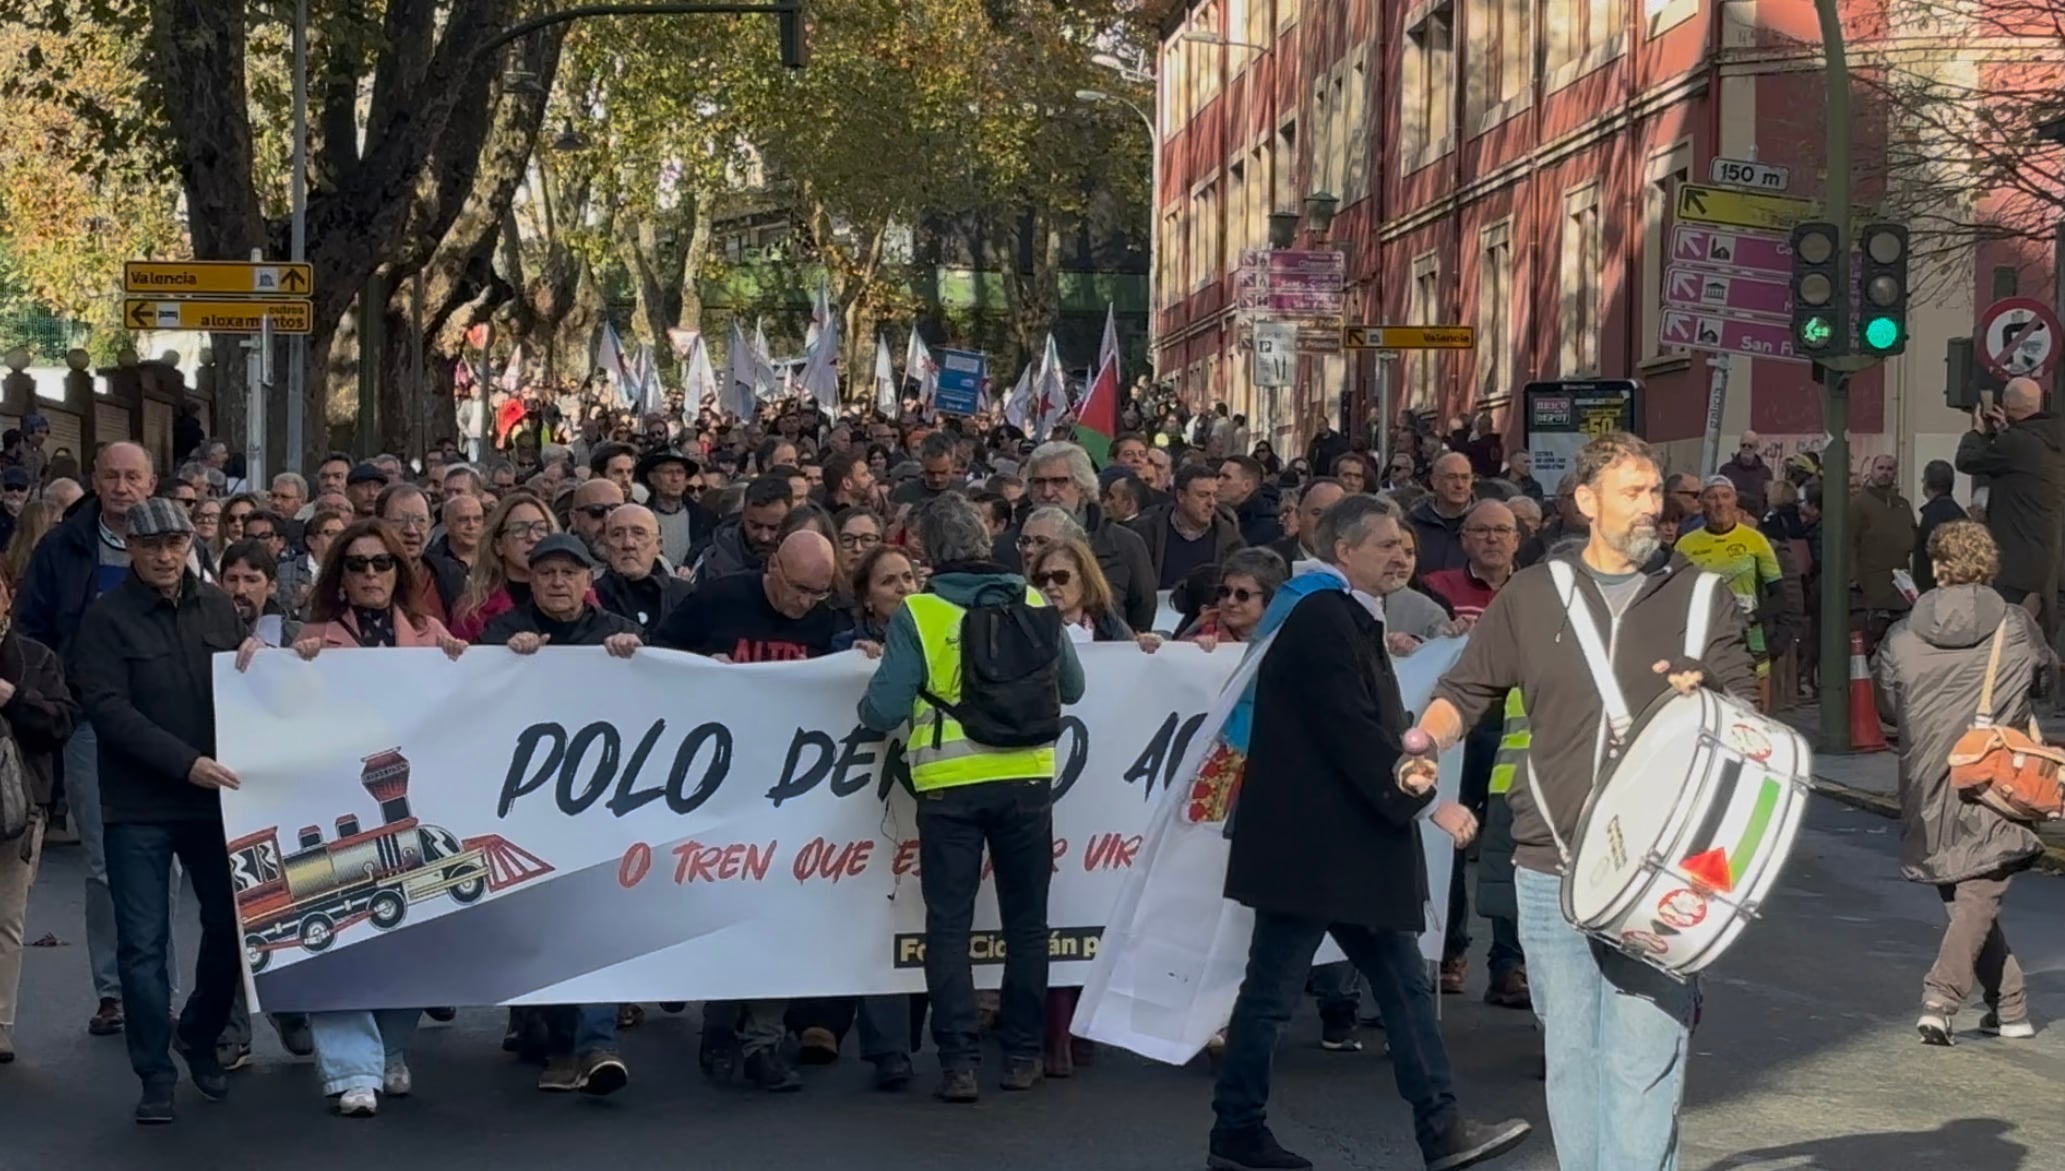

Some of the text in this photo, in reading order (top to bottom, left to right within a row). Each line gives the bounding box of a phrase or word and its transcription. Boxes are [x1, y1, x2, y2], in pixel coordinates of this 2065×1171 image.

[1720, 162, 1780, 186] 150 m
[130, 271, 197, 285] Valencia
[268, 305, 305, 315] outros
[201, 314, 305, 329] aloxamntos
[1423, 332, 1470, 343] Valencia
[1740, 336, 1773, 352] San
[497, 718, 733, 819] POLO
[618, 841, 653, 888] O
[671, 839, 777, 886] TREN
[792, 836, 875, 886] QUE
[1084, 832, 1143, 872] VIR
